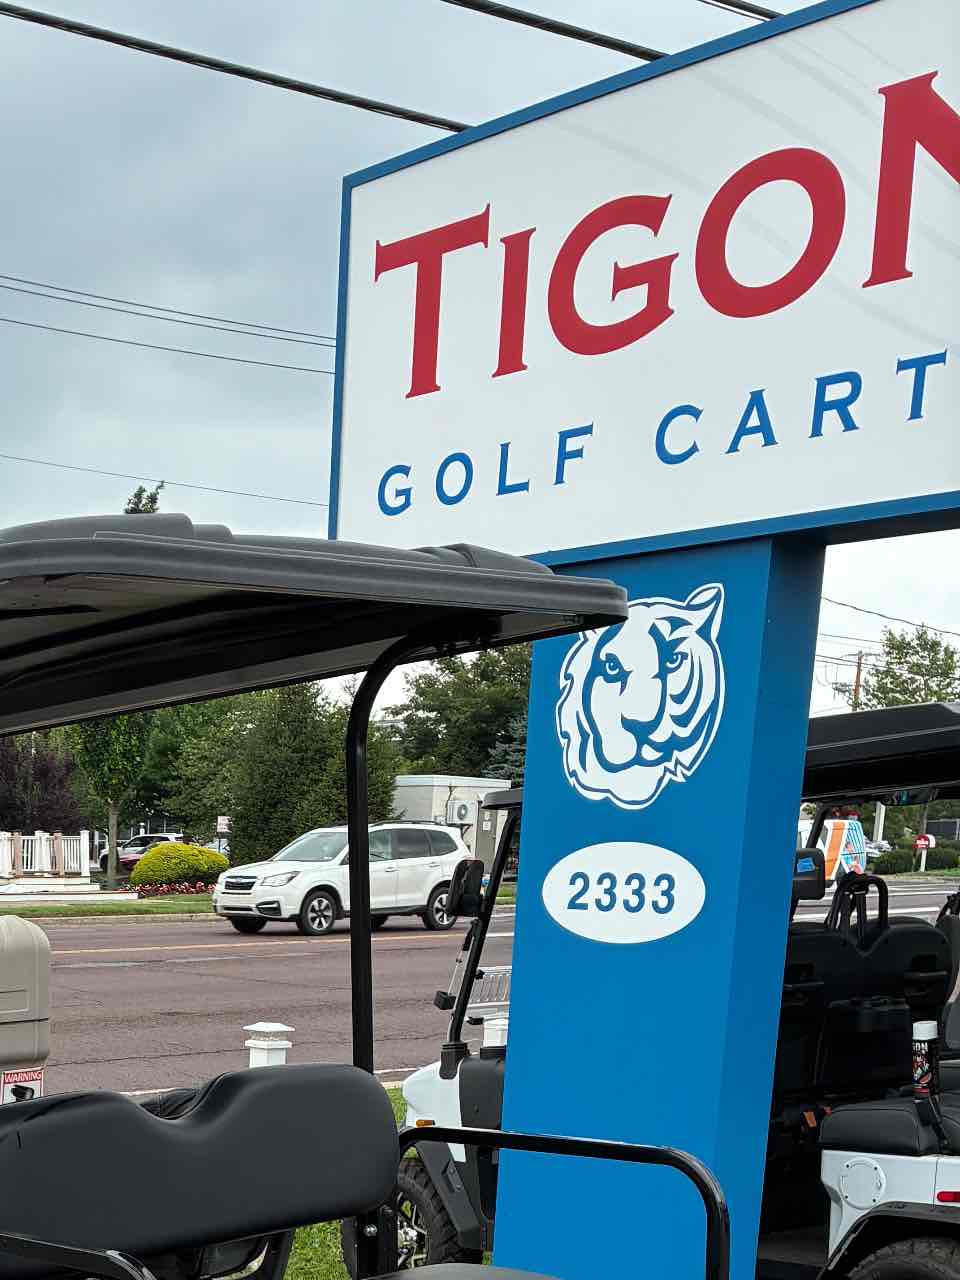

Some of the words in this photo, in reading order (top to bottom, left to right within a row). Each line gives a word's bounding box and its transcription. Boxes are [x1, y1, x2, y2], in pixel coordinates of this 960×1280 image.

[373, 71, 960, 399] TIGON
[377, 421, 594, 517] GOLF
[654, 348, 948, 465] CART
[566, 871, 676, 915] 2333
[5, 1071, 42, 1082] WARNING
